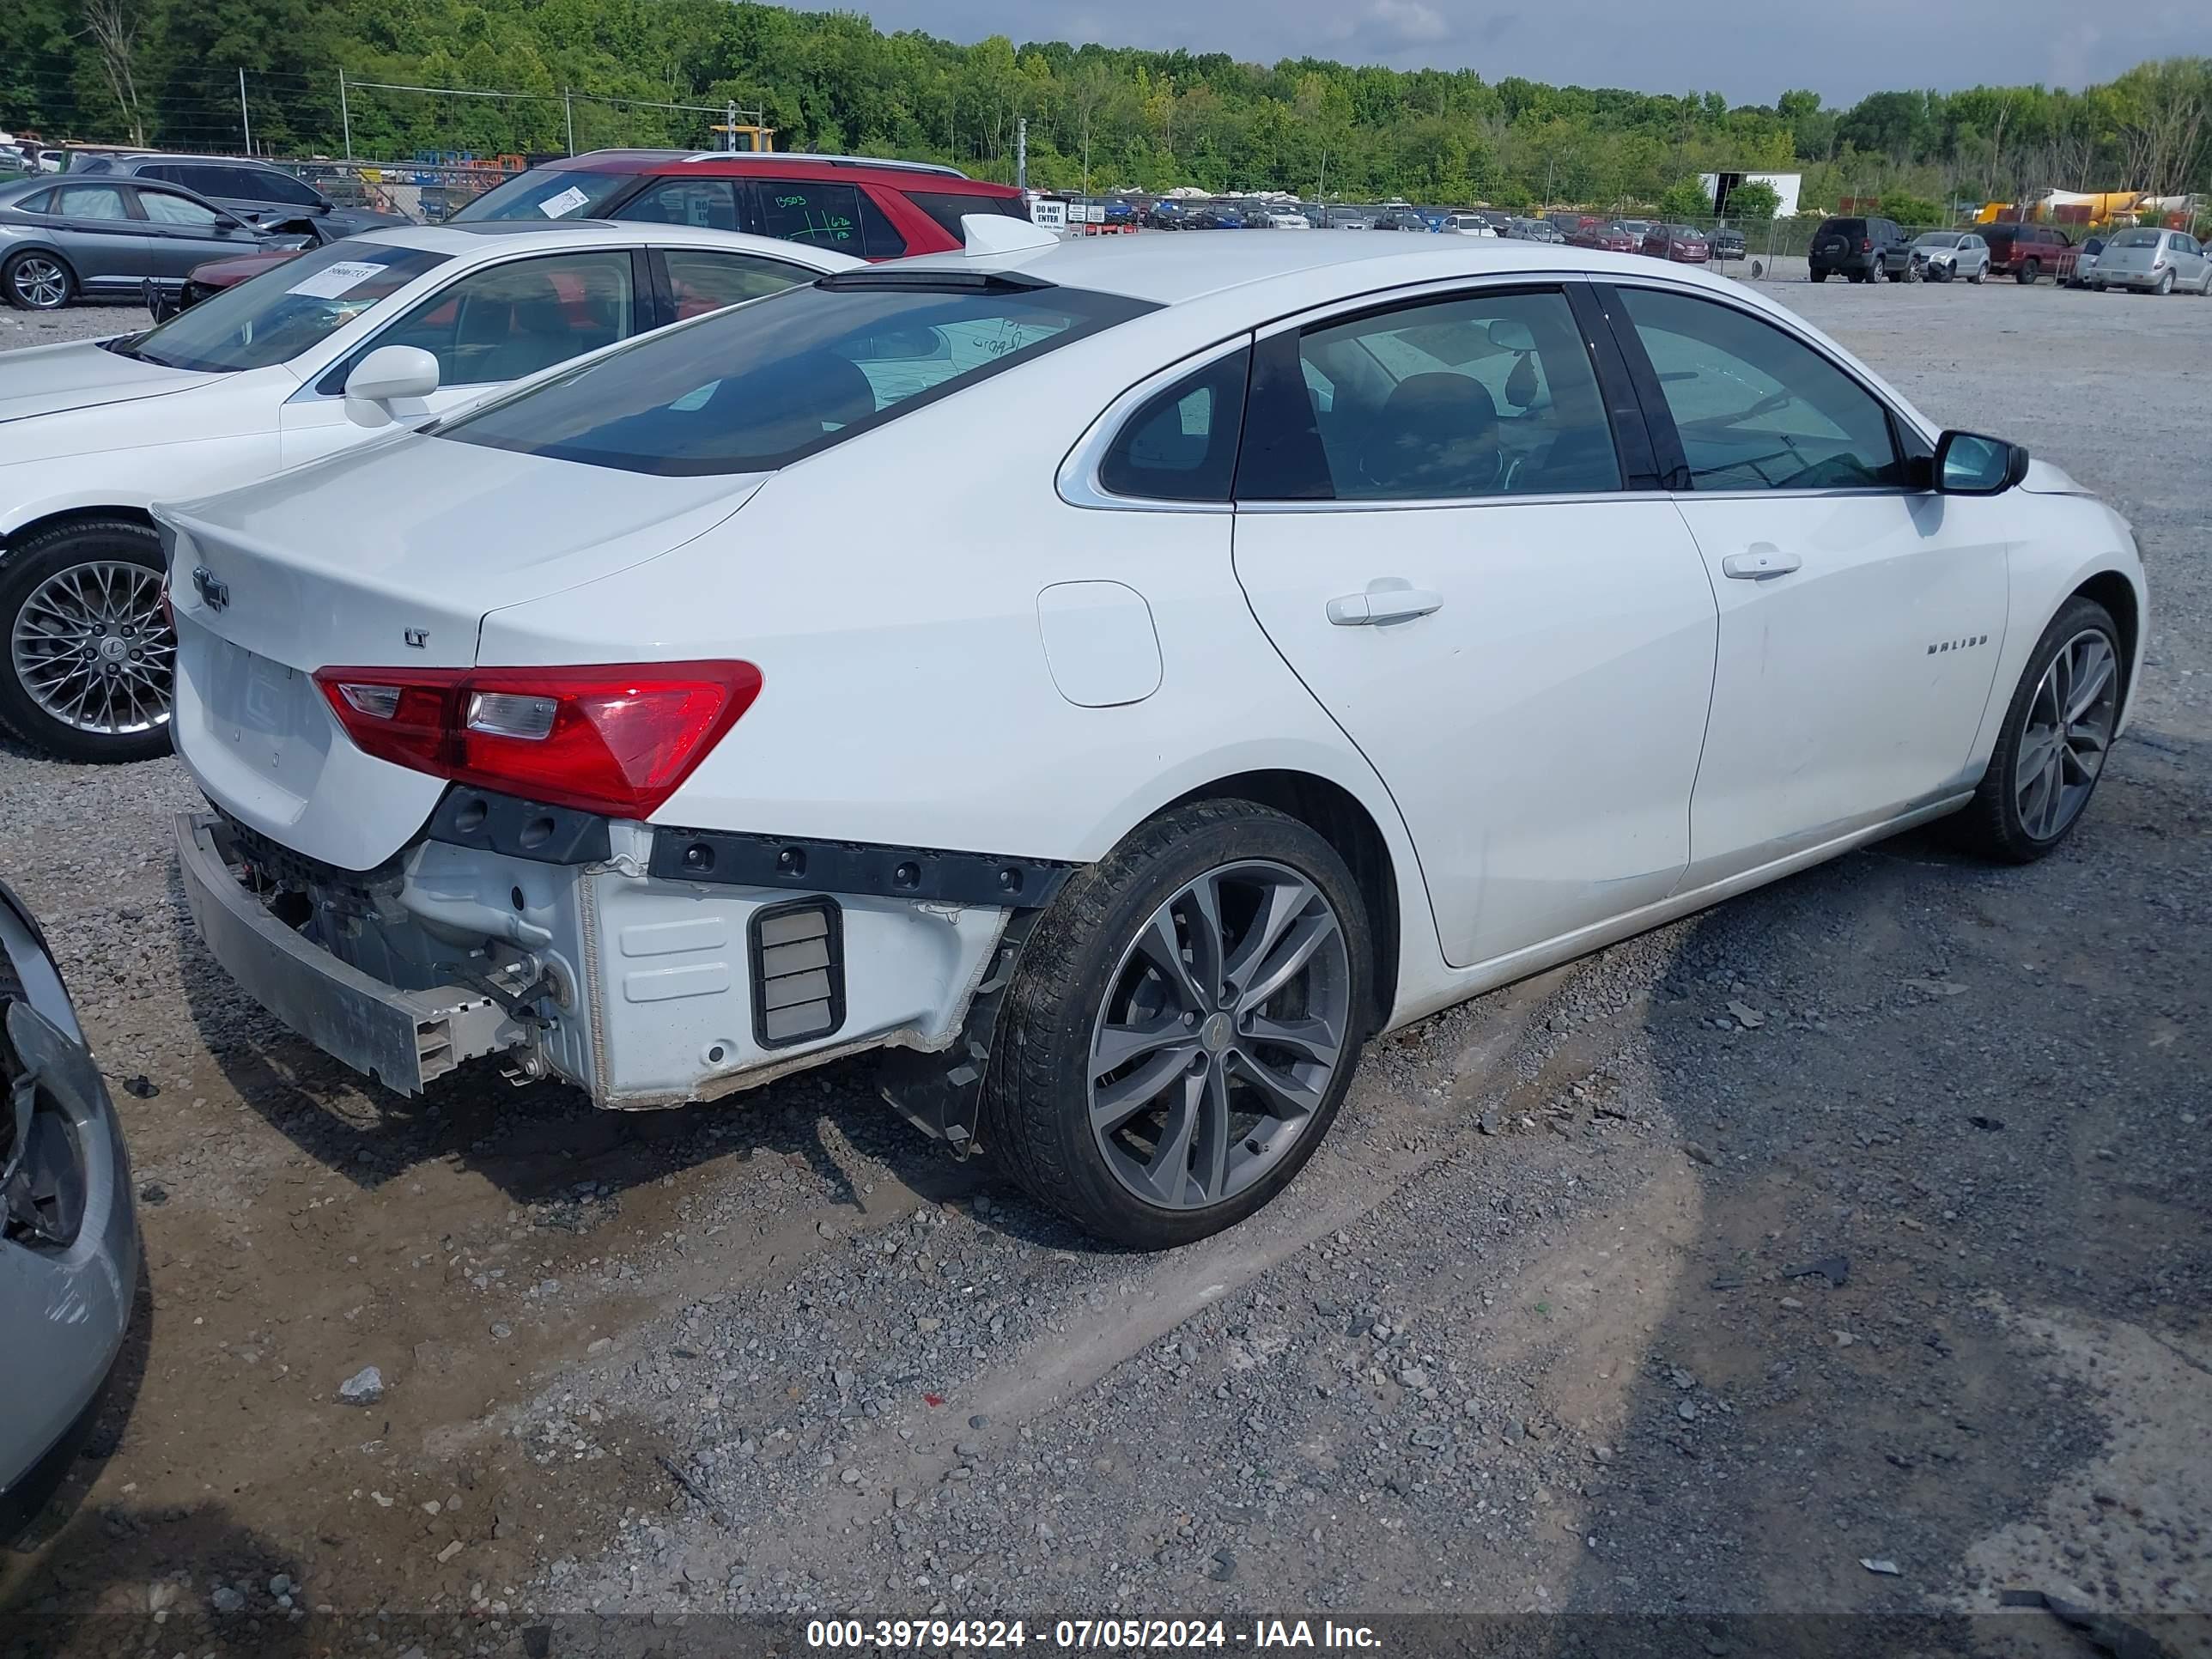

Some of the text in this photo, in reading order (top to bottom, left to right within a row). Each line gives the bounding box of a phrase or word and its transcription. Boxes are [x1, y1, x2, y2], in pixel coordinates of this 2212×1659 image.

[1036, 204, 1046, 214] DO
[1047, 205, 1060, 214] NOT
[1037, 214, 1059, 223] ENTER
[404, 626, 430, 650] LT
[1927, 634, 1988, 655] MALIBU
